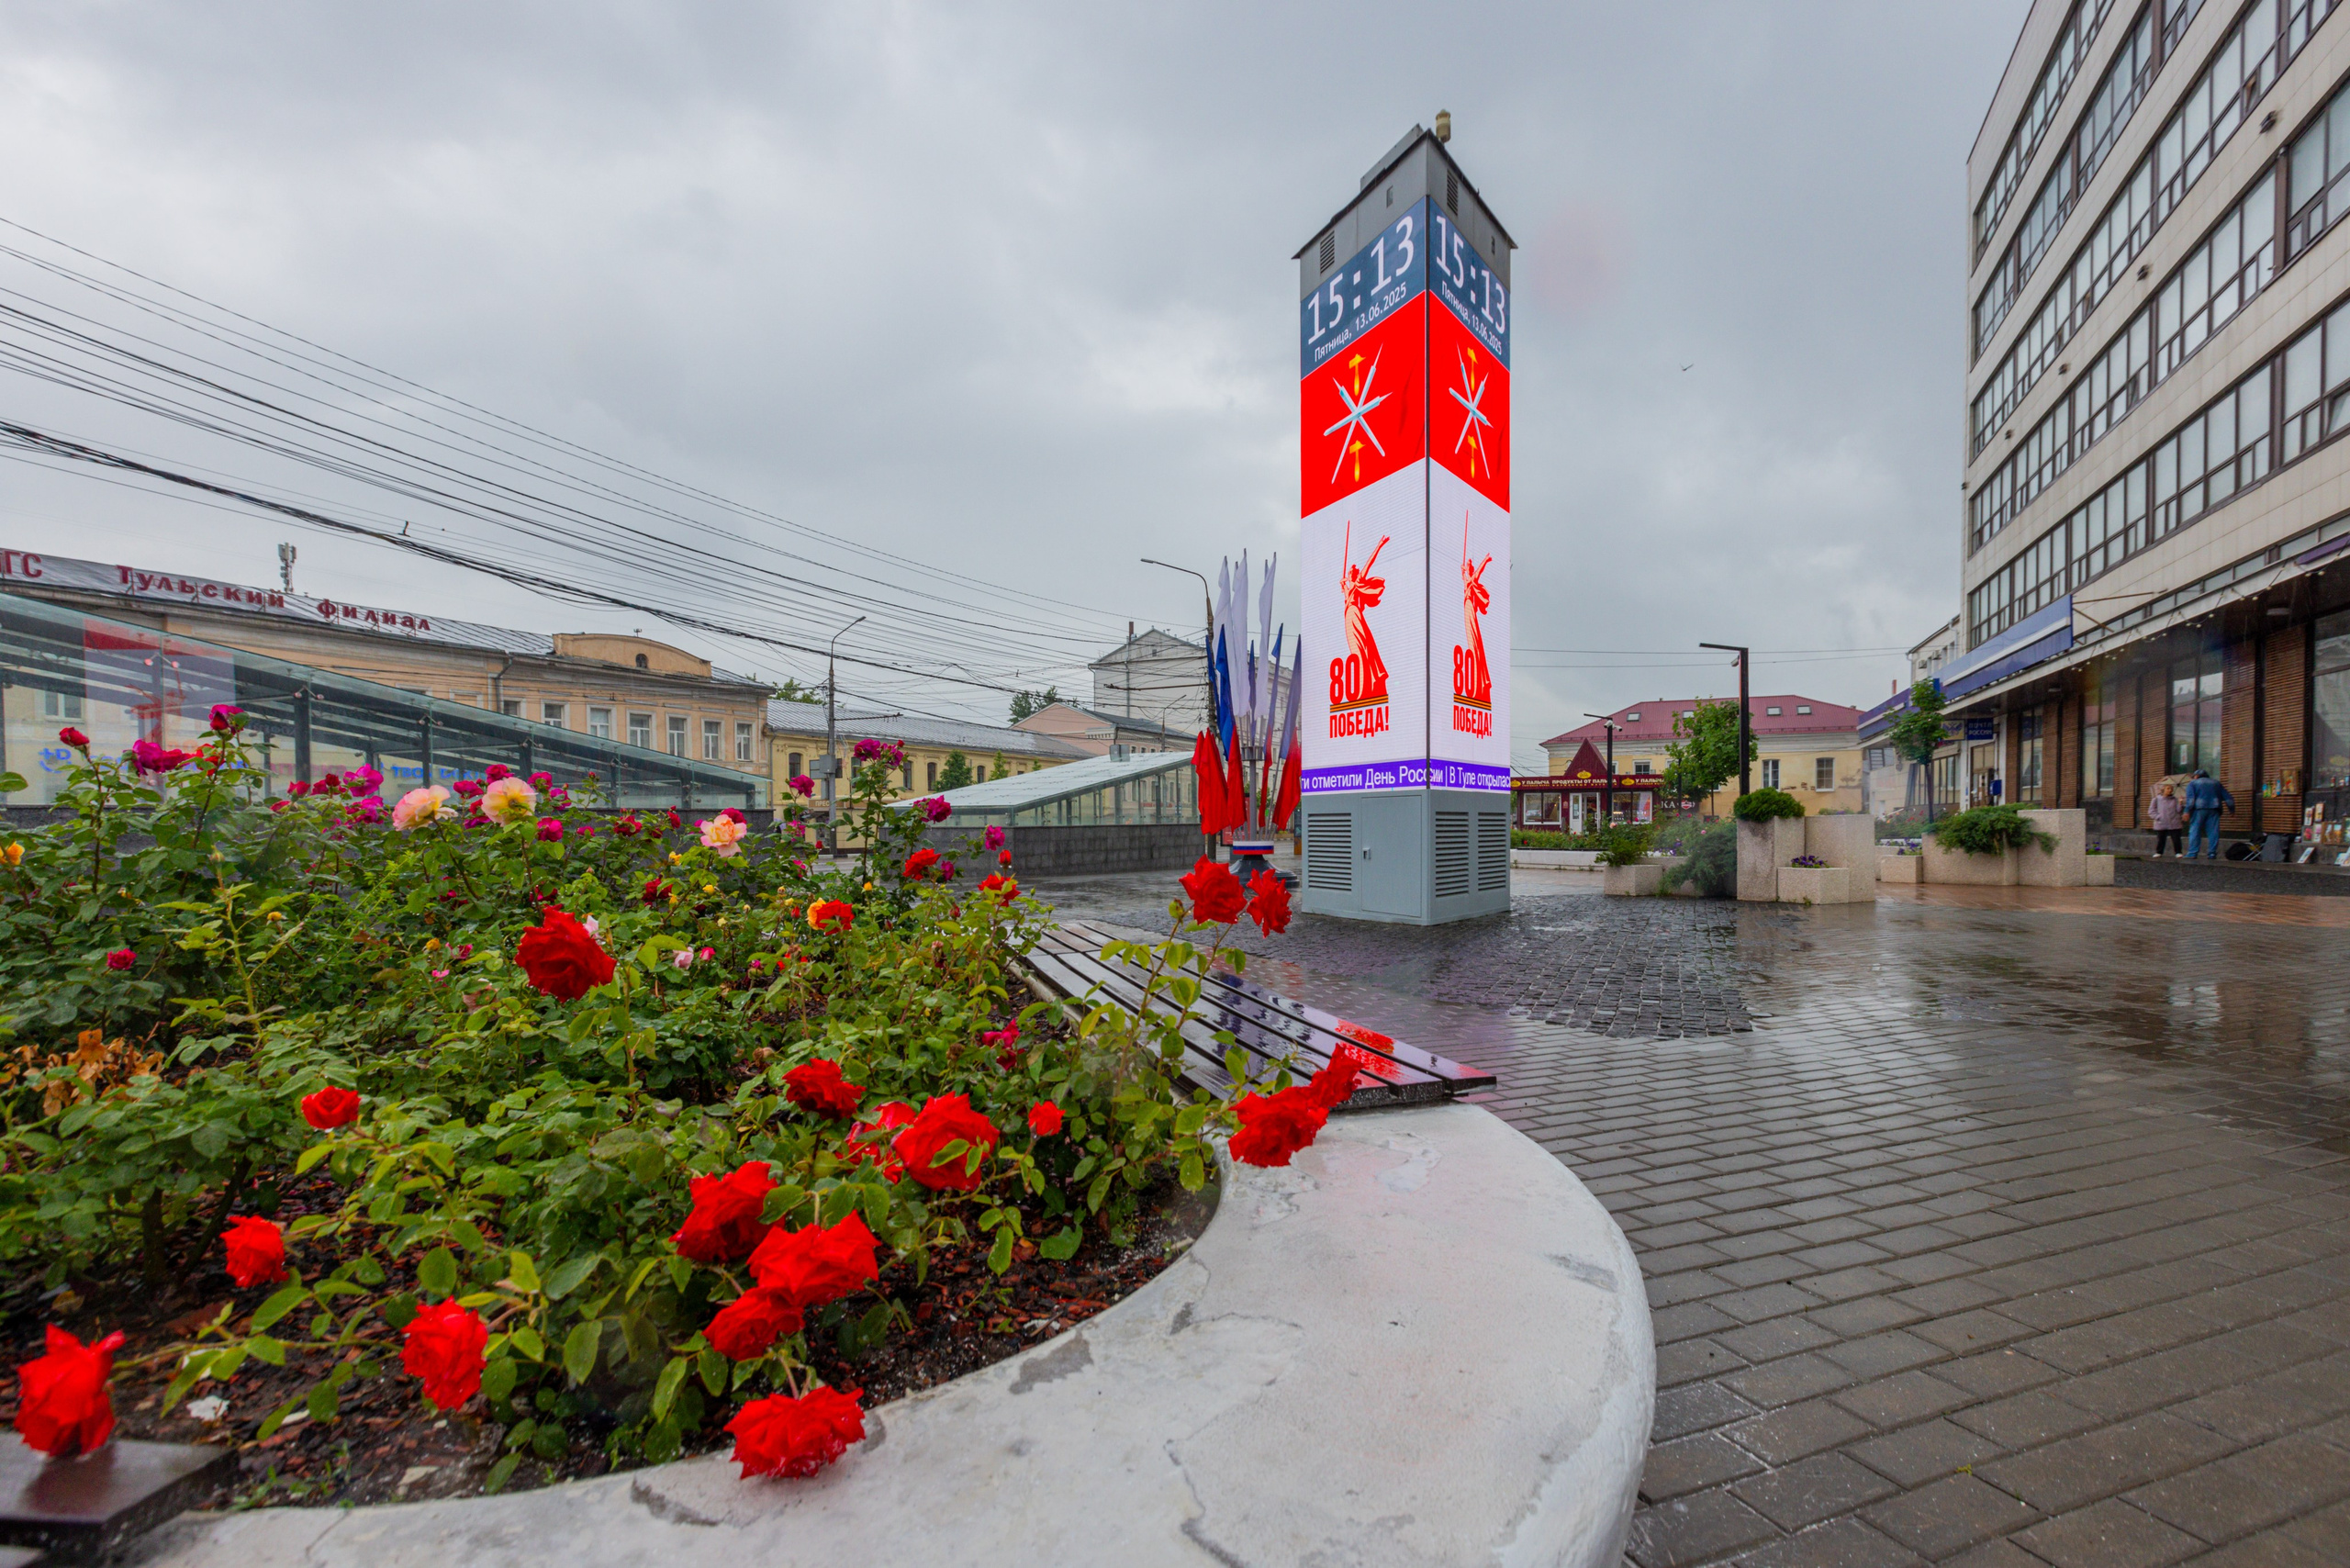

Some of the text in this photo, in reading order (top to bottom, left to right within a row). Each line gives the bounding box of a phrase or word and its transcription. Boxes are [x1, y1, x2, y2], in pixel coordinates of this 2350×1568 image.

[1308, 216, 1414, 345] 15:13
[1436, 215, 1505, 334] 15:13
[1315, 281, 1407, 363] Пятница, 13.06.2025
[1442, 280, 1502, 356] Пятница, 13.06.2025
[0, 550, 431, 631] ГС Тульский филиал
[1329, 653, 1360, 705] 80
[1453, 644, 1474, 698] 80
[1329, 705, 1389, 738] ПОБЕДА!
[1453, 705, 1493, 739] ПОБЕДА!
[391, 766, 432, 778] ТВО
[1312, 773, 1362, 789] отметили
[1365, 768, 1395, 790] День
[1449, 766, 1456, 783] В
[1457, 767, 1476, 789] Туле
[1477, 773, 1510, 790] открылас
